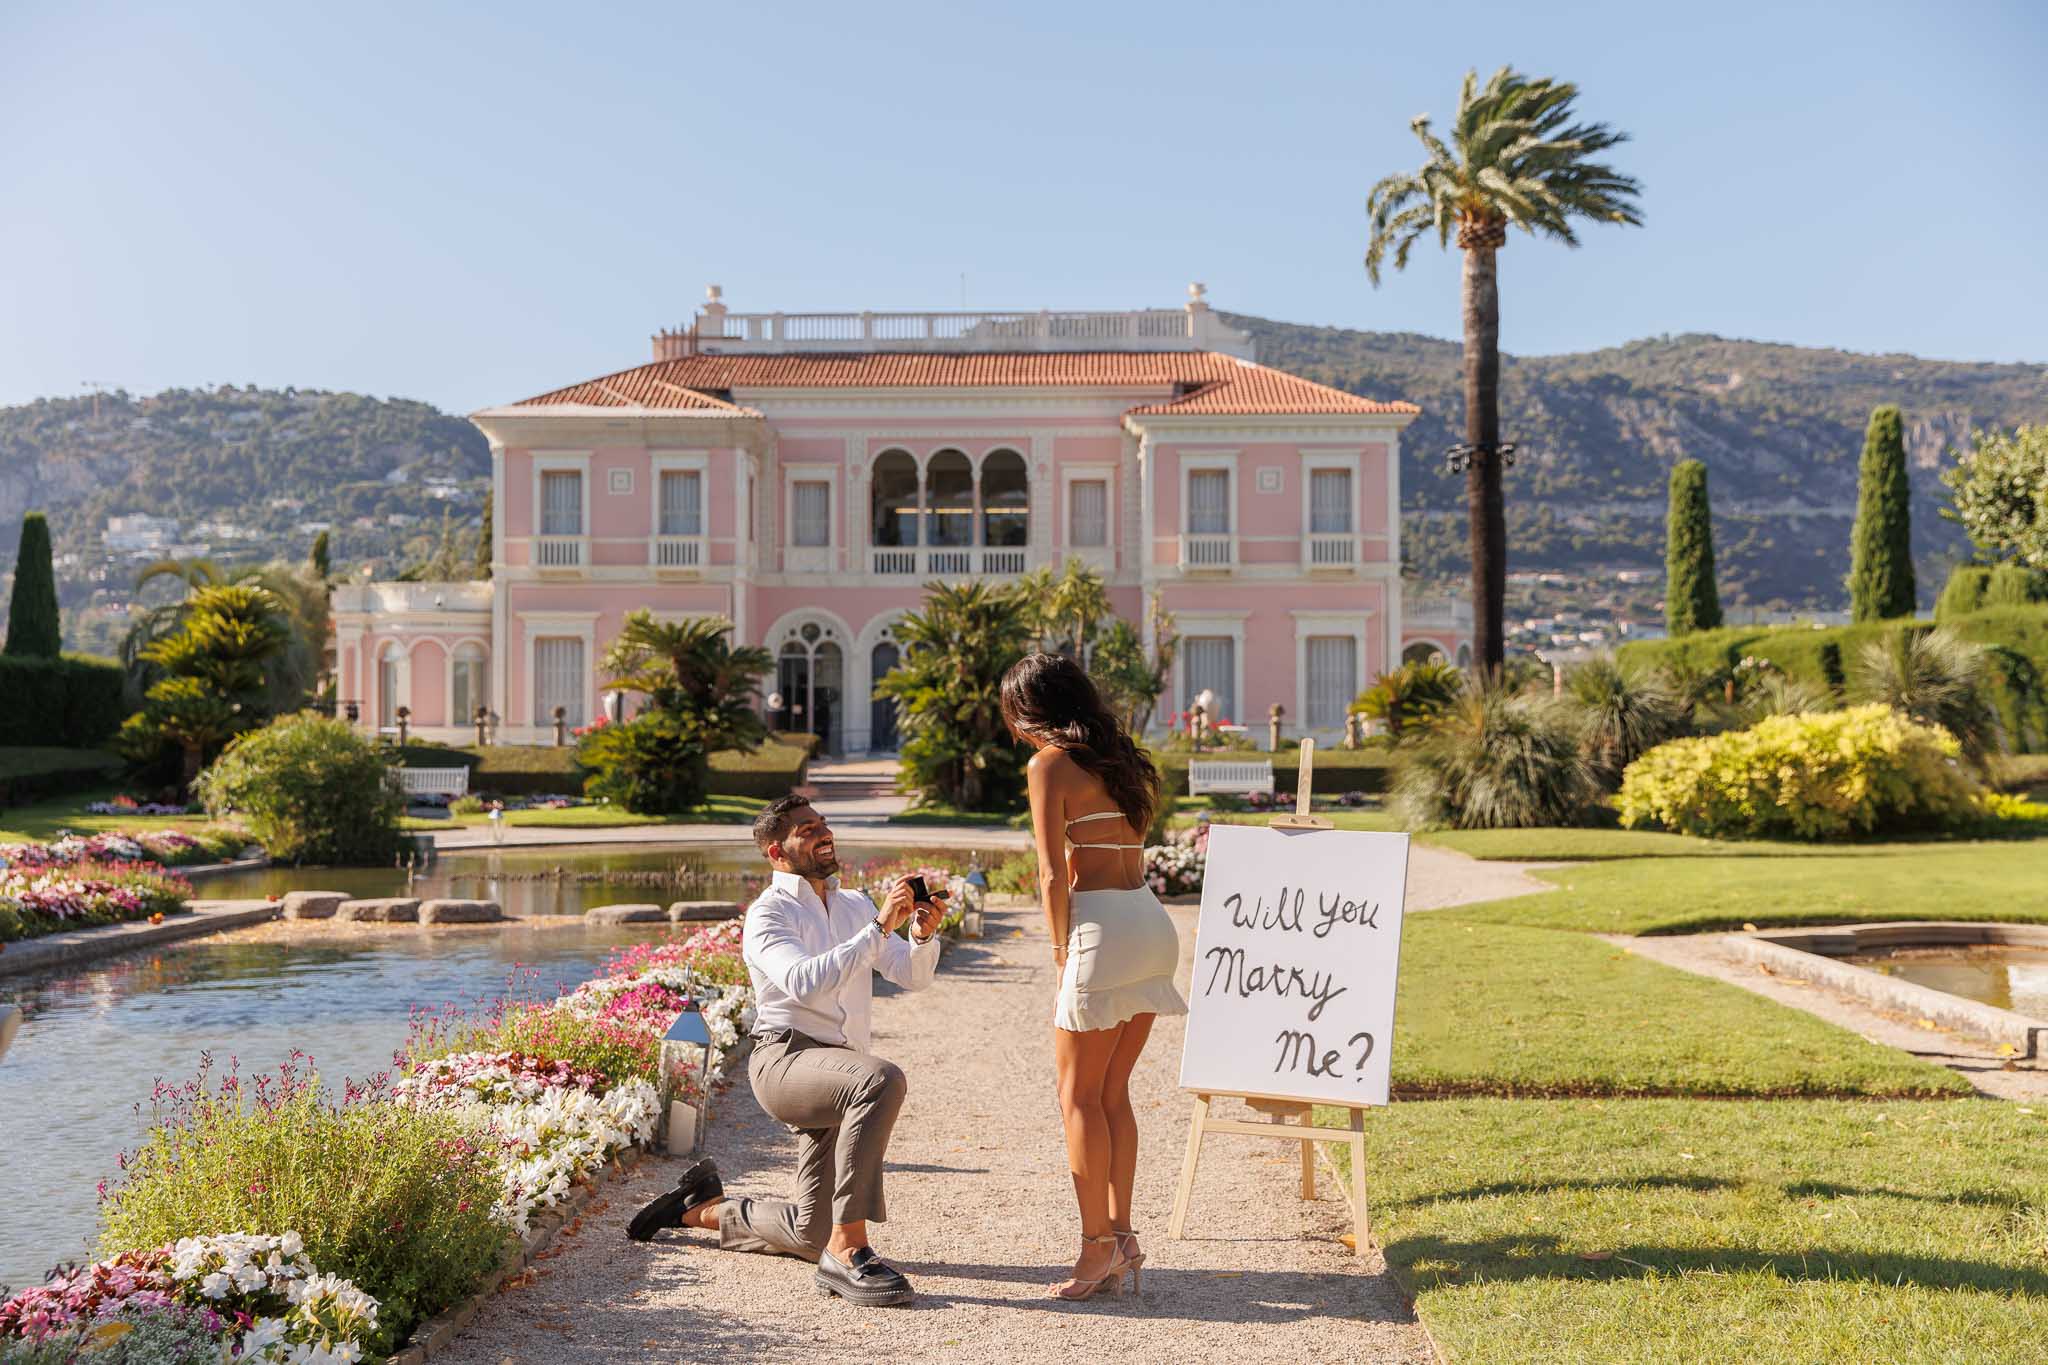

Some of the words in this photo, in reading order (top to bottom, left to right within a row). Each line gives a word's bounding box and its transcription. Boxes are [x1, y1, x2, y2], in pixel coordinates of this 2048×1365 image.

[1223, 886, 1305, 933] Will
[1204, 946, 1348, 1022] Marry
[1274, 1029, 1375, 1083] Me?
